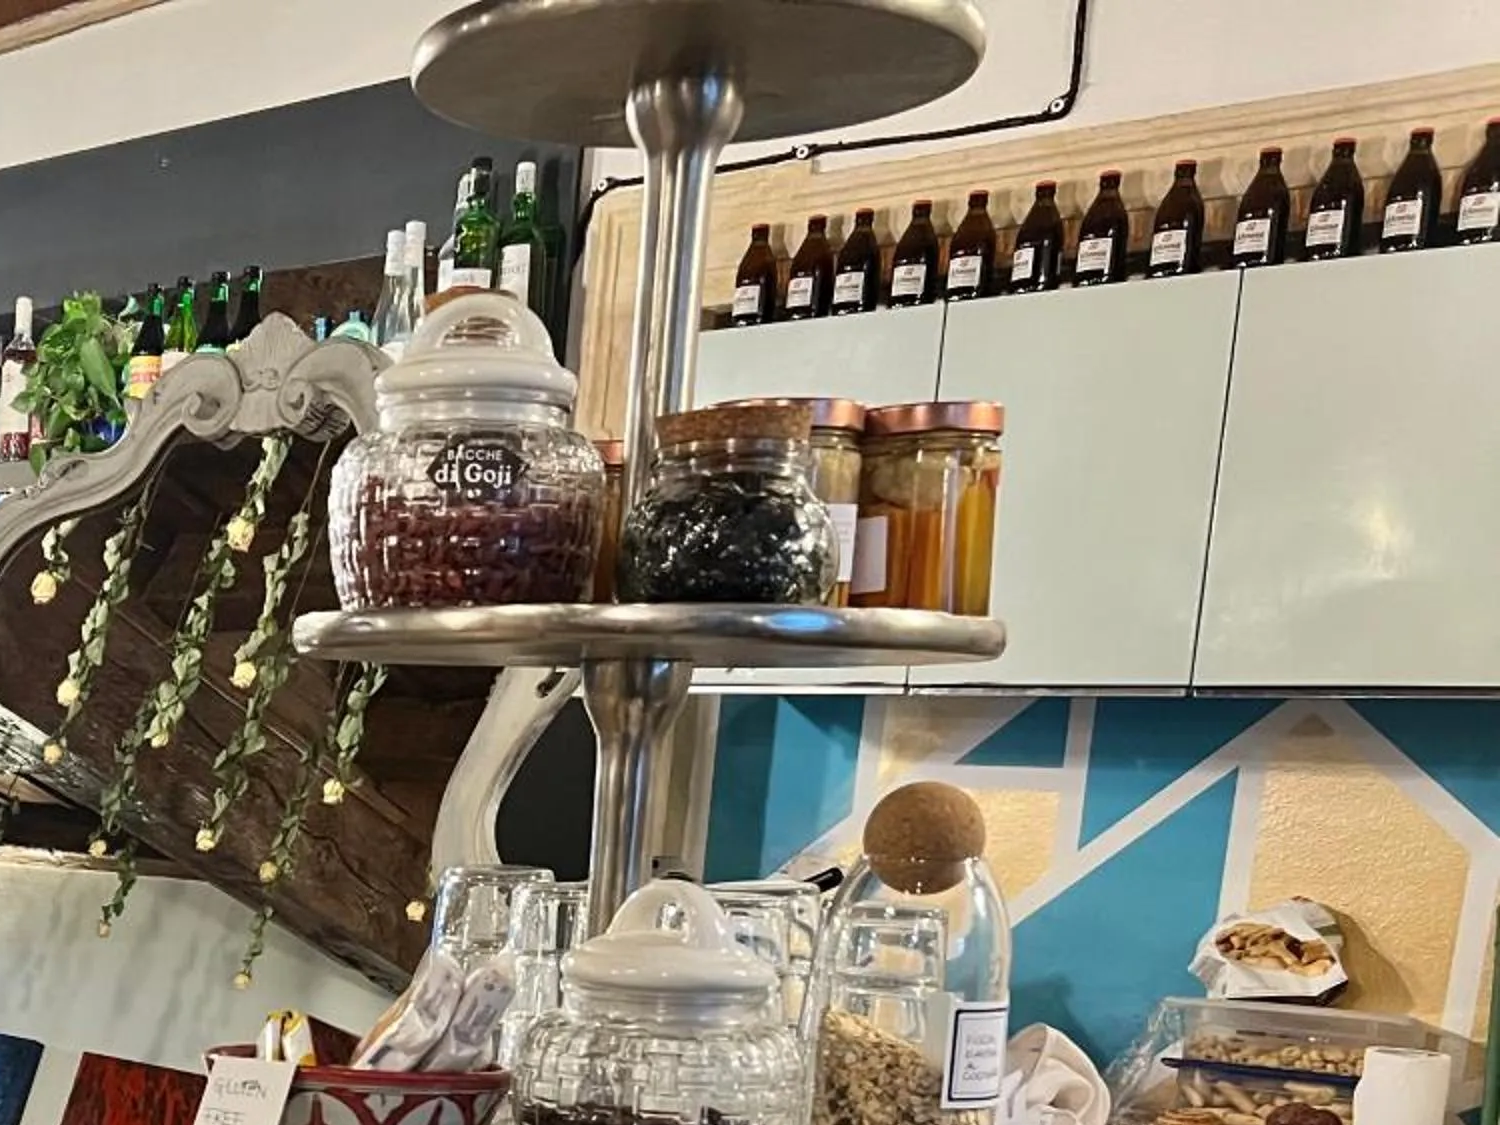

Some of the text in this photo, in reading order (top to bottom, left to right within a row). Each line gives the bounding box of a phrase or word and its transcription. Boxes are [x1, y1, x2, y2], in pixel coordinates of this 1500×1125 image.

[447, 449, 503, 461] BACCHE
[435, 462, 512, 489] di Goji
